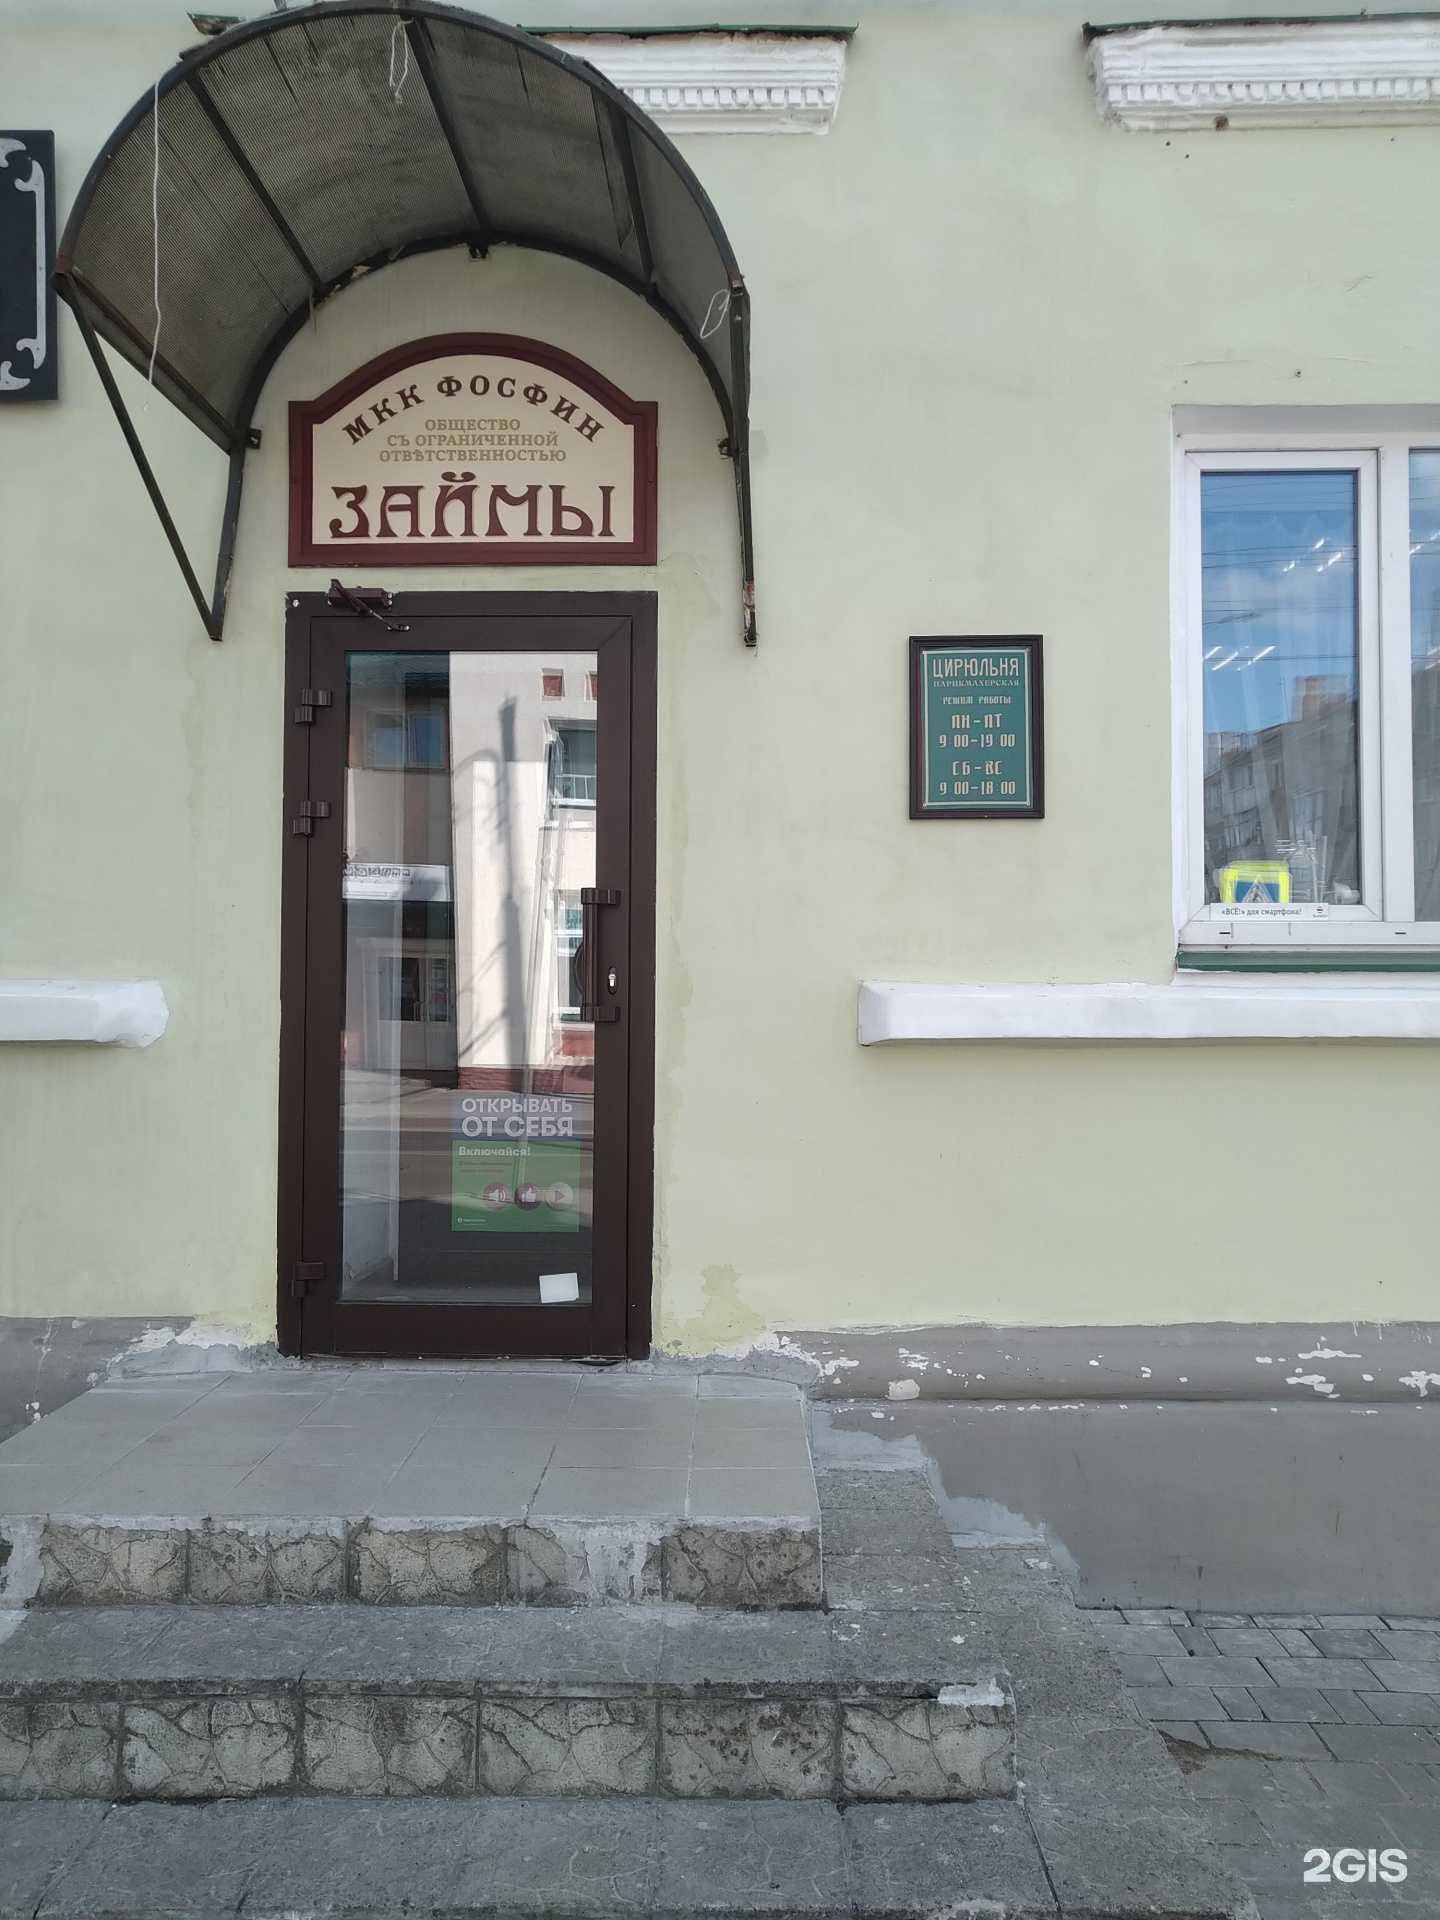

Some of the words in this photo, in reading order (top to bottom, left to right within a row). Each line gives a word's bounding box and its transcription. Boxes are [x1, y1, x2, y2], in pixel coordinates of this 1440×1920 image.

[342, 383, 425, 445] МКК
[436, 374, 605, 443] ФОСФИН
[425, 418, 520, 433] ОБЩЕСТВО
[387, 434, 410, 447] СЪ
[415, 431, 558, 447] ОГРАНИЧЕННОЙ
[329, 471, 615, 538] ЗАЙМЫ
[933, 657, 1019, 678] ЦИРЮЛЬНЯ
[933, 679, 1019, 688] ПАРИКМАХЕРСКАЯ
[942, 696, 973, 705] РЕЖИМ
[978, 695, 1011, 705] РАБОТЫ
[1247, 909, 1260, 917] для
[462, 1098, 573, 1113] ОТКРЫВАТЬ
[461, 1116, 498, 1137] ОТ
[504, 1116, 573, 1137] СЕБЯ
[458, 1145, 531, 1157] Включайся!
